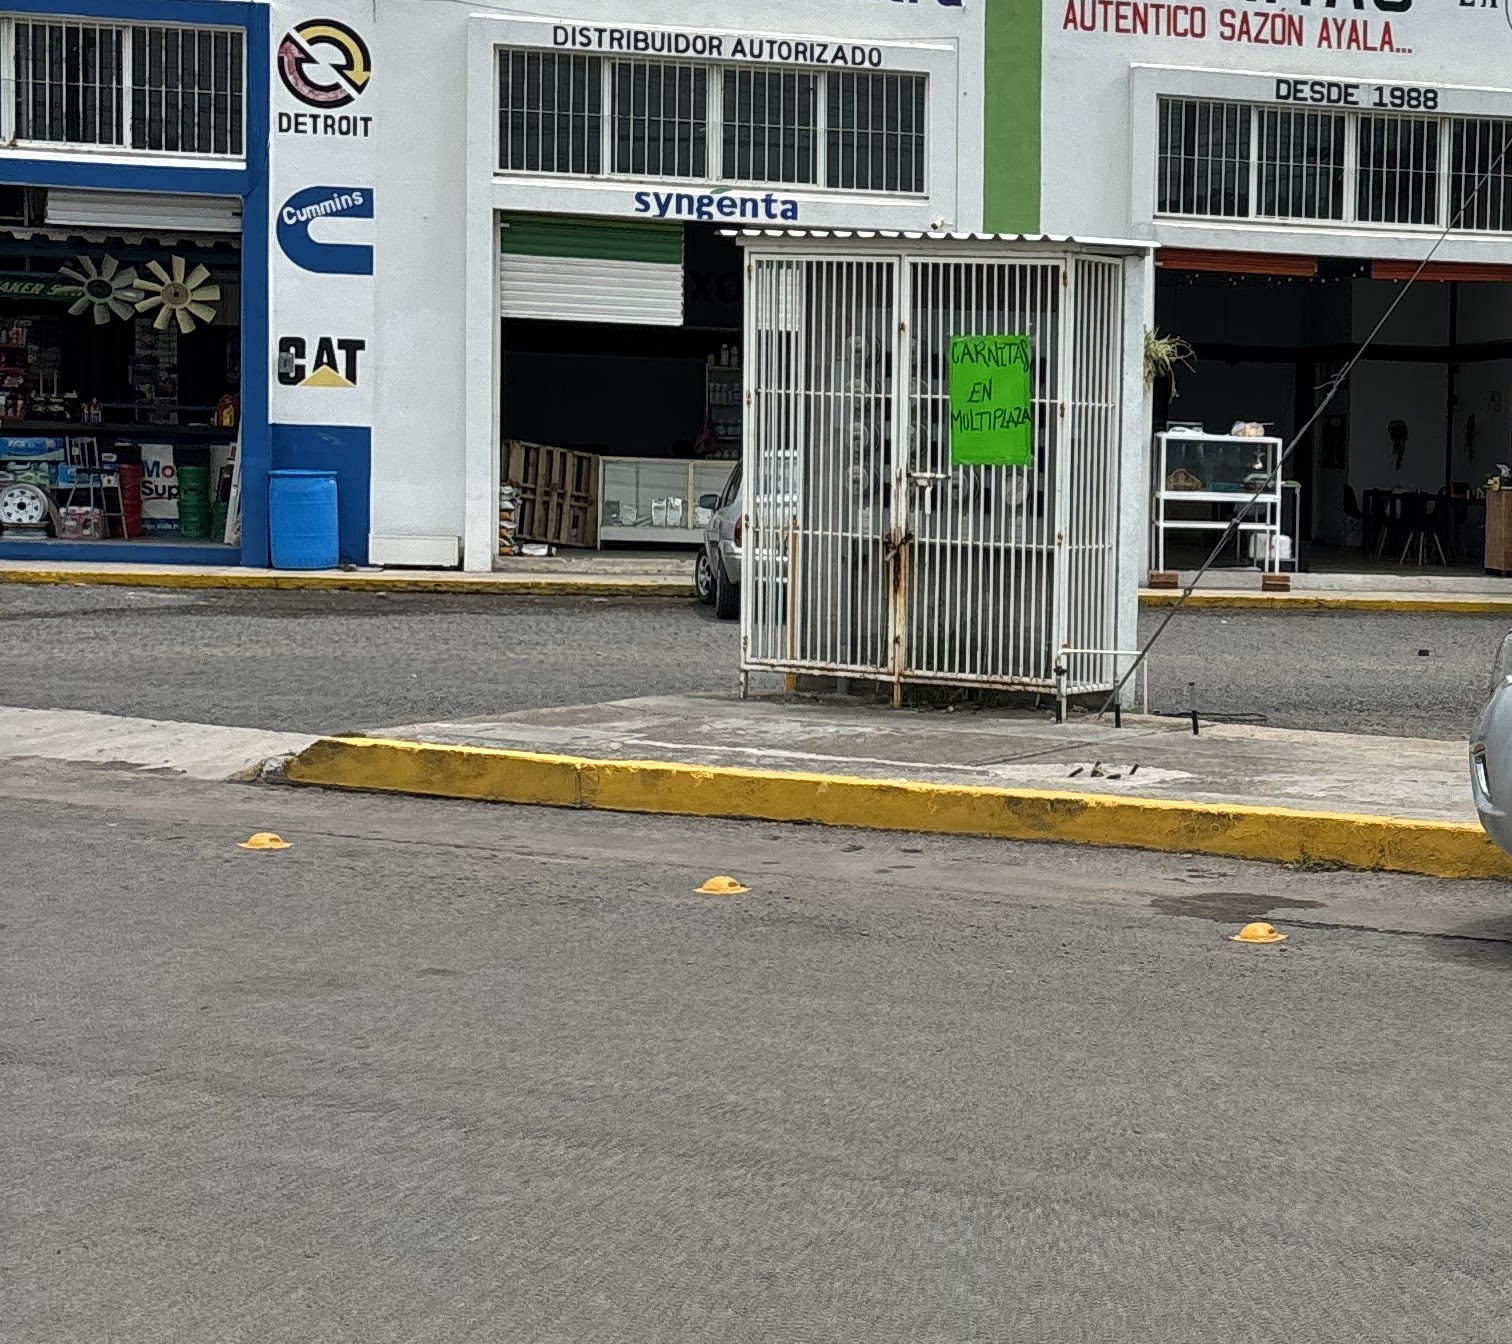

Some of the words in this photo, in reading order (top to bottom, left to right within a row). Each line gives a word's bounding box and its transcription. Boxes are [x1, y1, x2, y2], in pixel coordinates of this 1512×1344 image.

[1219, 7, 1304, 47] SAZÓN
[552, 25, 723, 57] DISTRIBUIDOR
[731, 36, 883, 68] AUTORIZADO
[1275, 78, 1360, 106] DESDE
[1372, 85, 1439, 110] 1988
[277, 111, 373, 138] DETROIT
[281, 190, 364, 225] Cummins
[634, 190, 799, 221] syngenta
[0, 281, 45, 295] AKER
[278, 336, 366, 386] CAT
[951, 339, 1029, 373] CARNITAS
[967, 378, 993, 403] EN
[950, 406, 1032, 433] MULTIPLAZA
